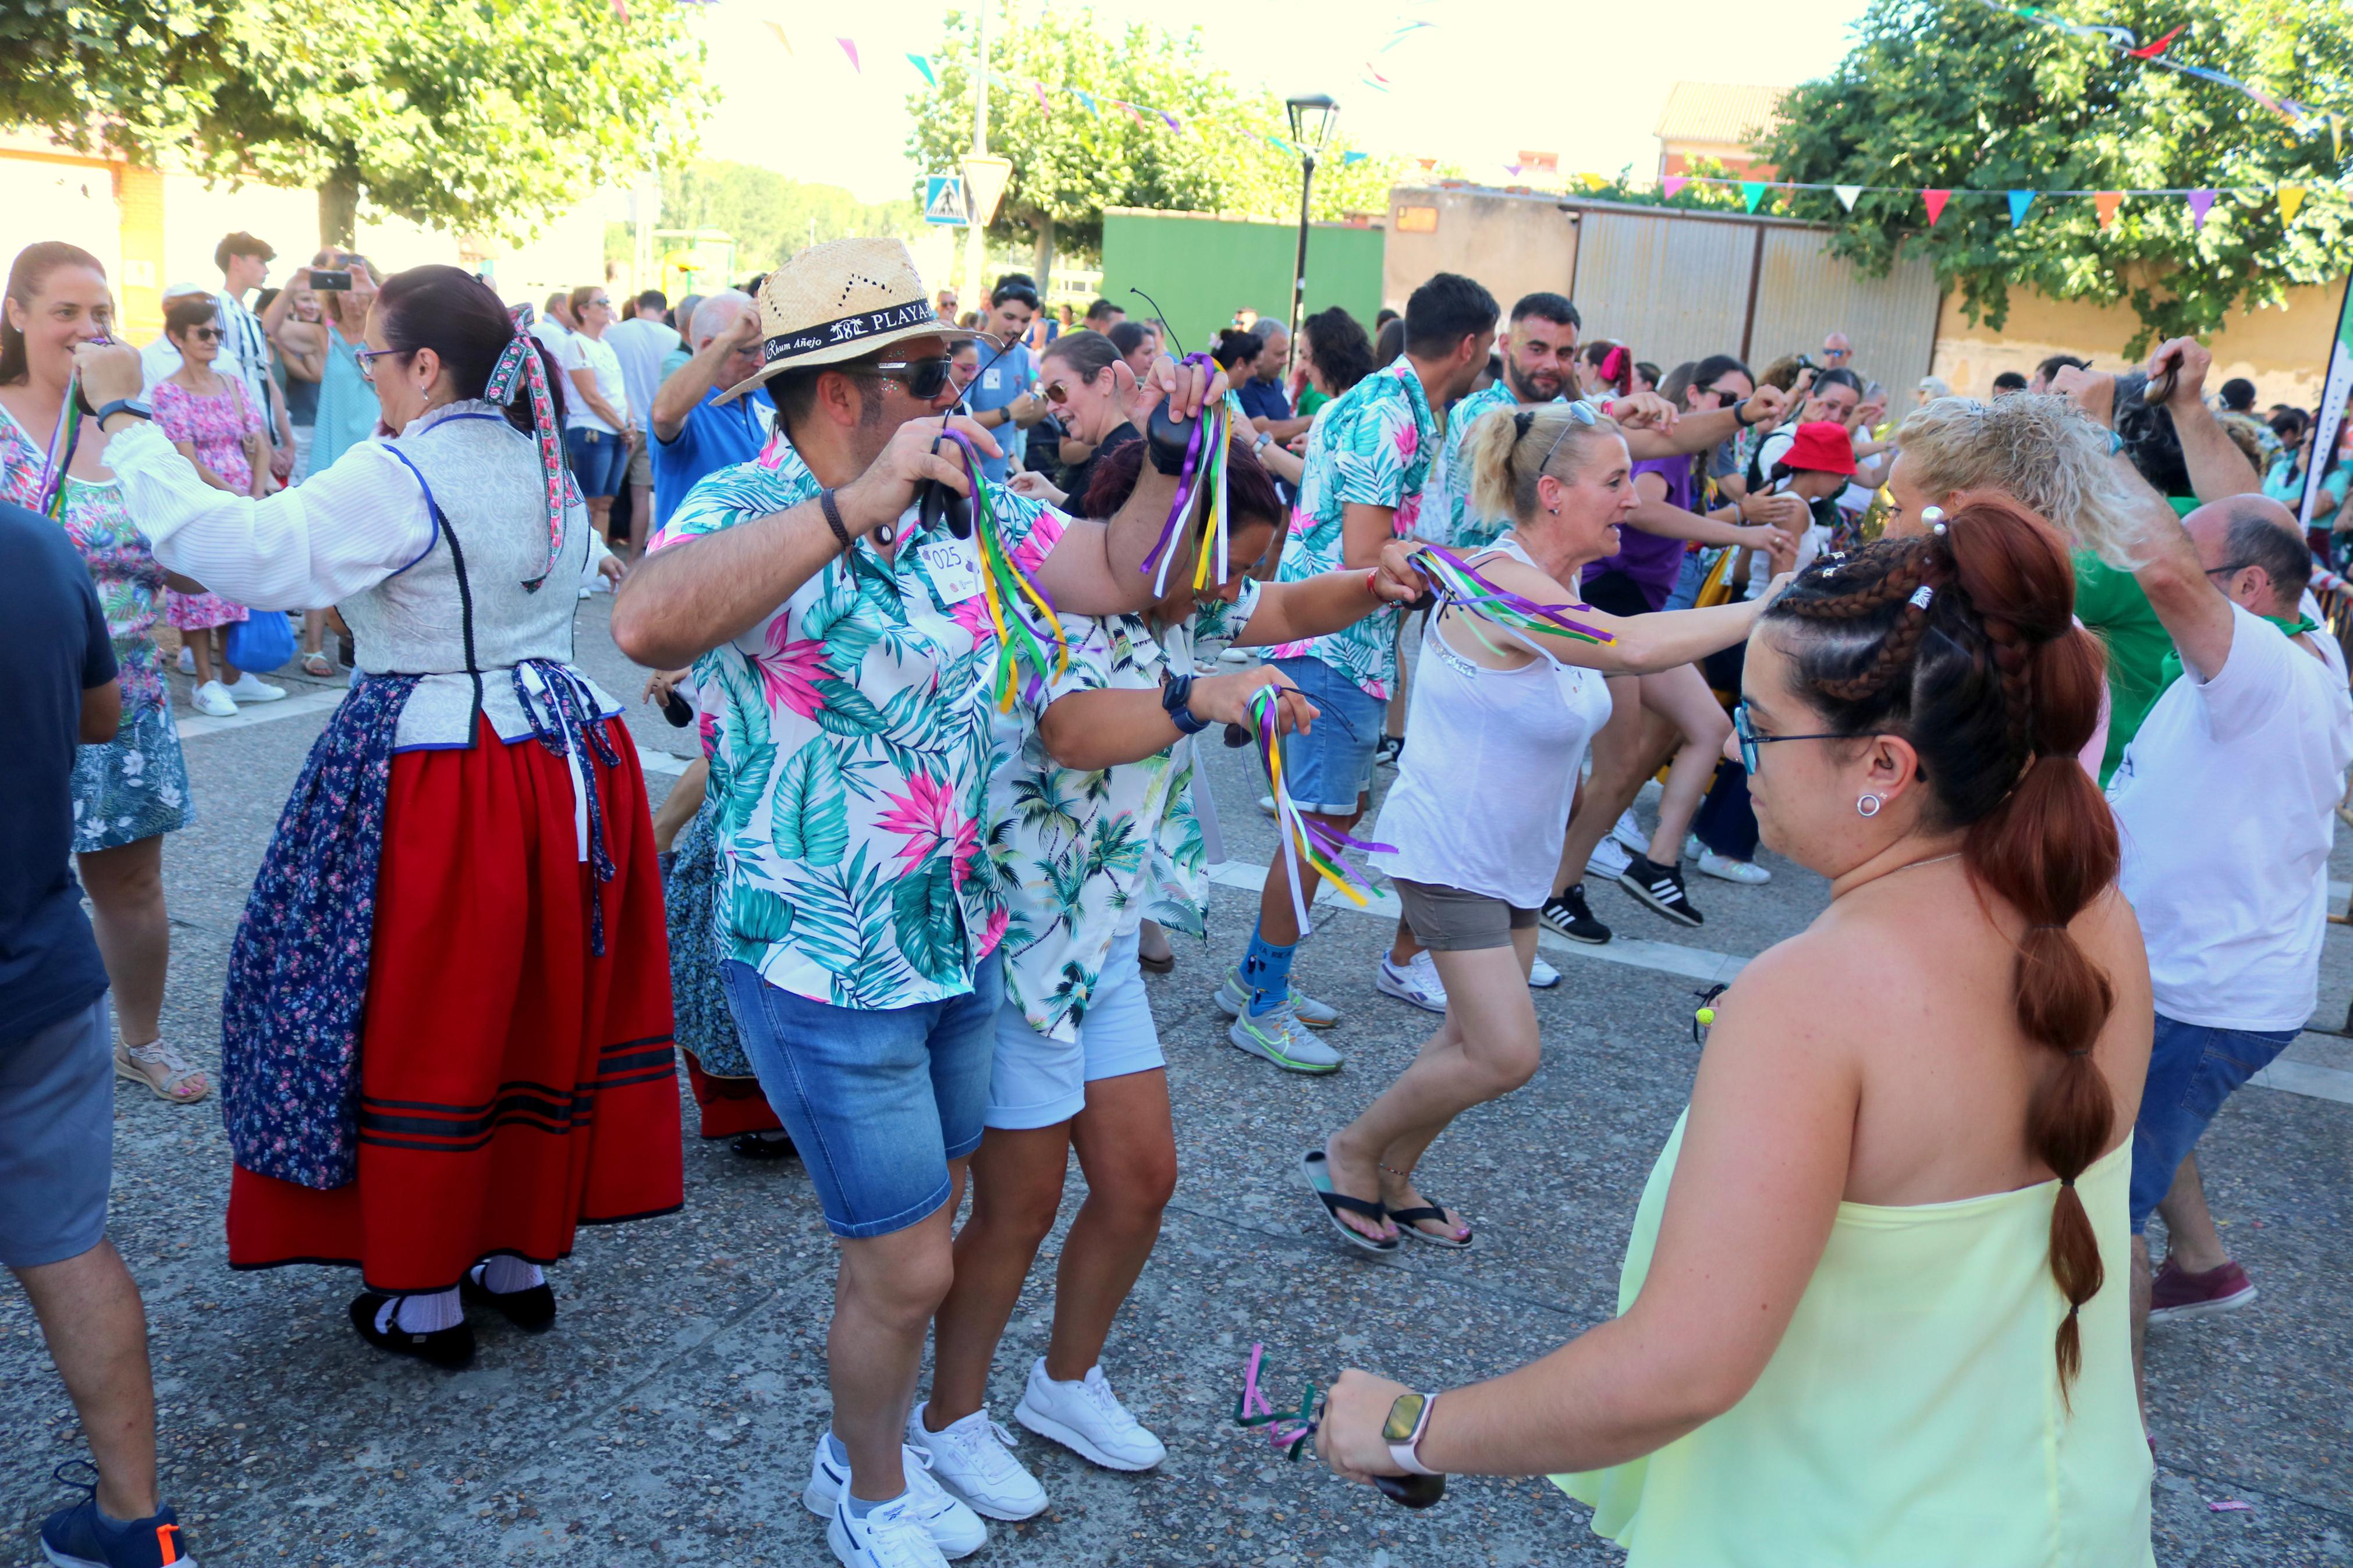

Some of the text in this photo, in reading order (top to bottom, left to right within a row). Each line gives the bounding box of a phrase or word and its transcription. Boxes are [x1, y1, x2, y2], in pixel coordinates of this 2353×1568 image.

[766, 339, 791, 360] Rhum
[793, 337, 822, 349] Añejo
[932, 546, 961, 569] 025
[883, 1503, 906, 1516] Reebok
